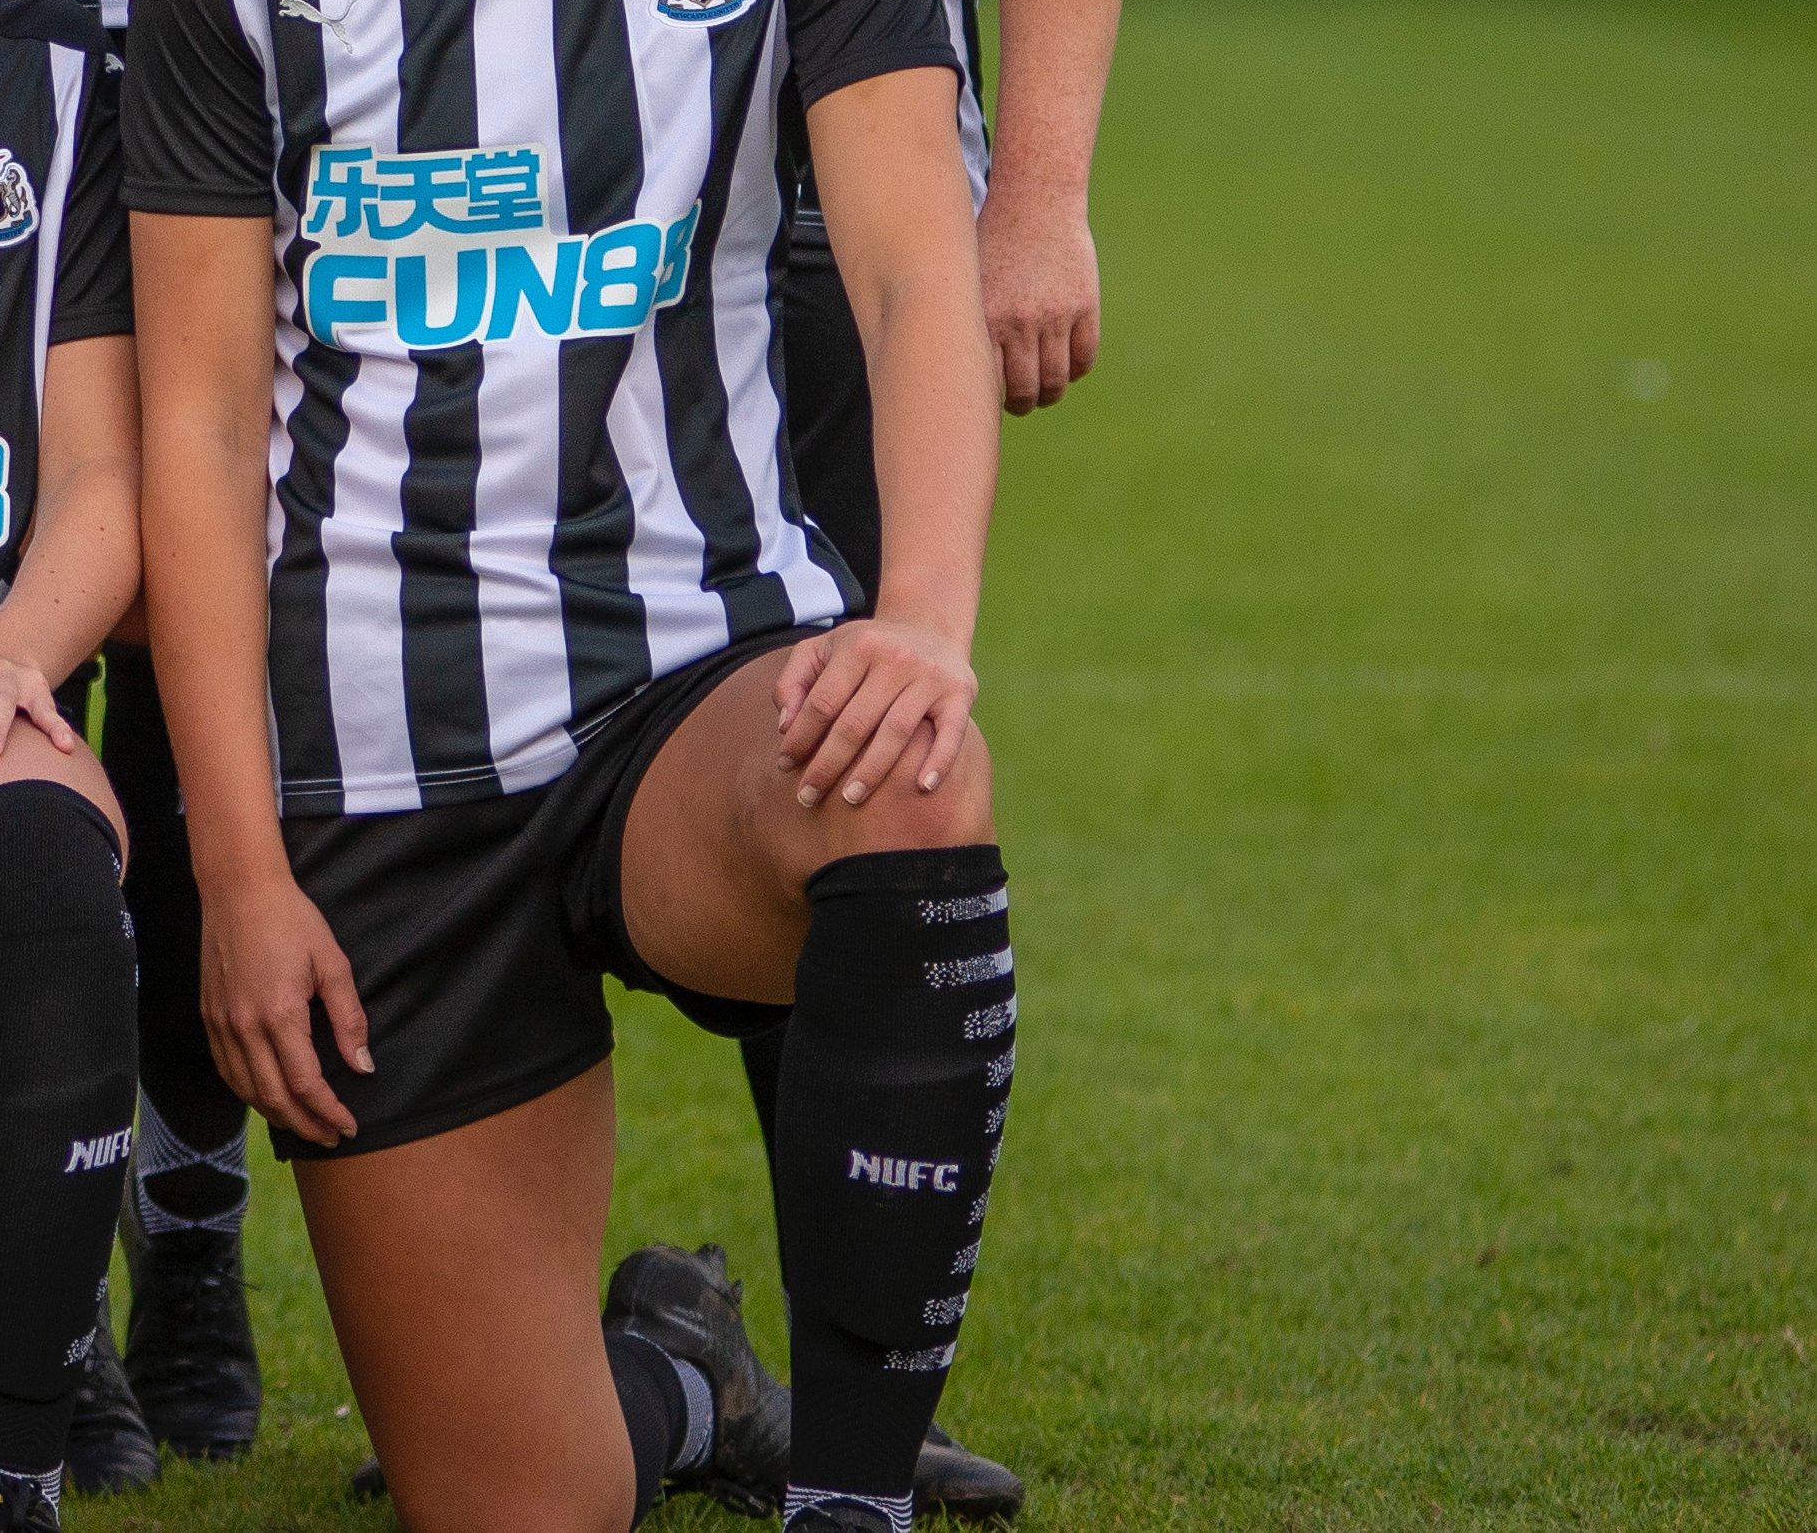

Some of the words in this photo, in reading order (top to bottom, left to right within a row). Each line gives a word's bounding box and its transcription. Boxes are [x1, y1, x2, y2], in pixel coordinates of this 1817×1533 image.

[306, 147, 544, 241] 乐天堂
[847, 1148, 960, 1193] NUFC
